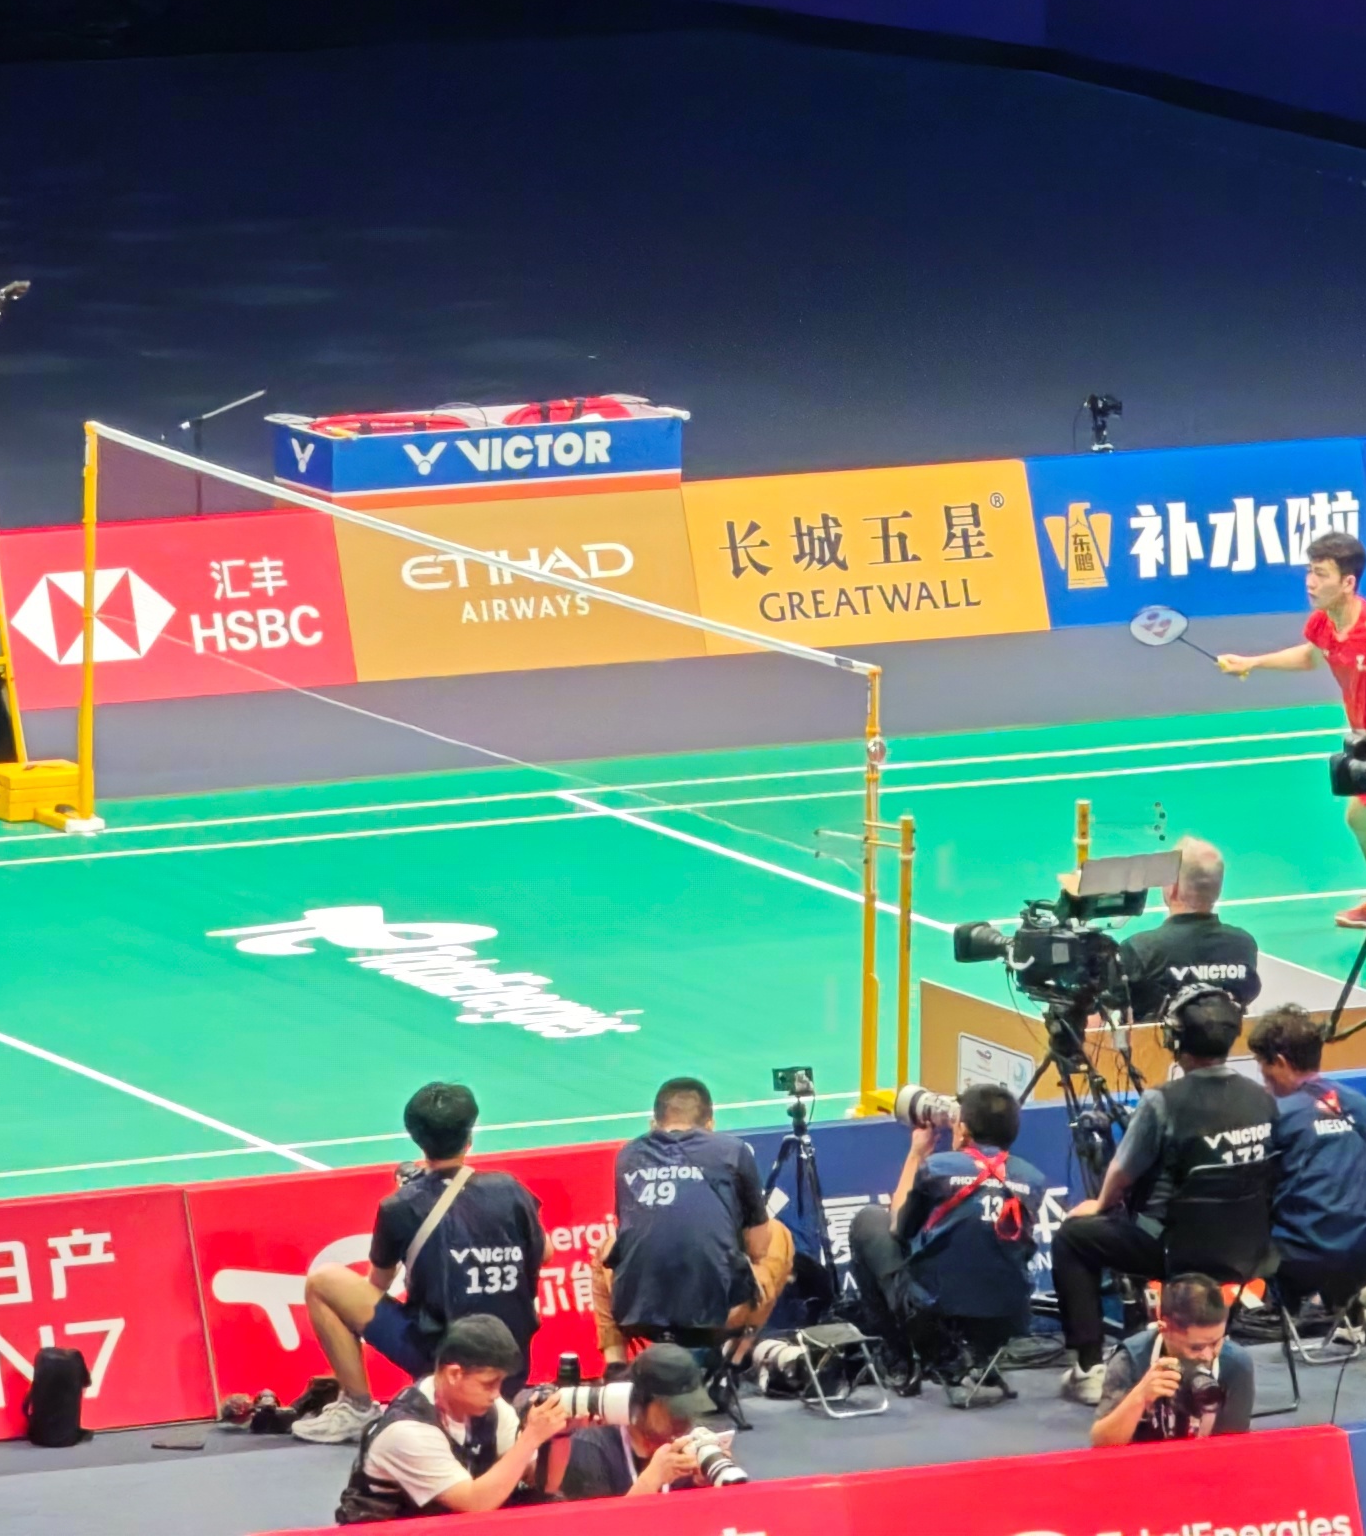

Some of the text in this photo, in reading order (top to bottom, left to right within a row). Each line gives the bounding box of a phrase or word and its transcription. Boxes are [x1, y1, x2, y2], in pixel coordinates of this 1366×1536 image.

[456, 430, 611, 473] VICTOR
[719, 500, 994, 581] 长城五星
[208, 556, 288, 602] 汇丰
[400, 542, 636, 592] ETIHAD
[460, 591, 592, 625] AIRWAYS
[190, 606, 323, 655] HSBC
[1189, 964, 1246, 979] VICTOR
[1223, 1122, 1272, 1141] VICTOR
[637, 1182, 677, 1207] 49
[465, 1265, 519, 1295] 133
